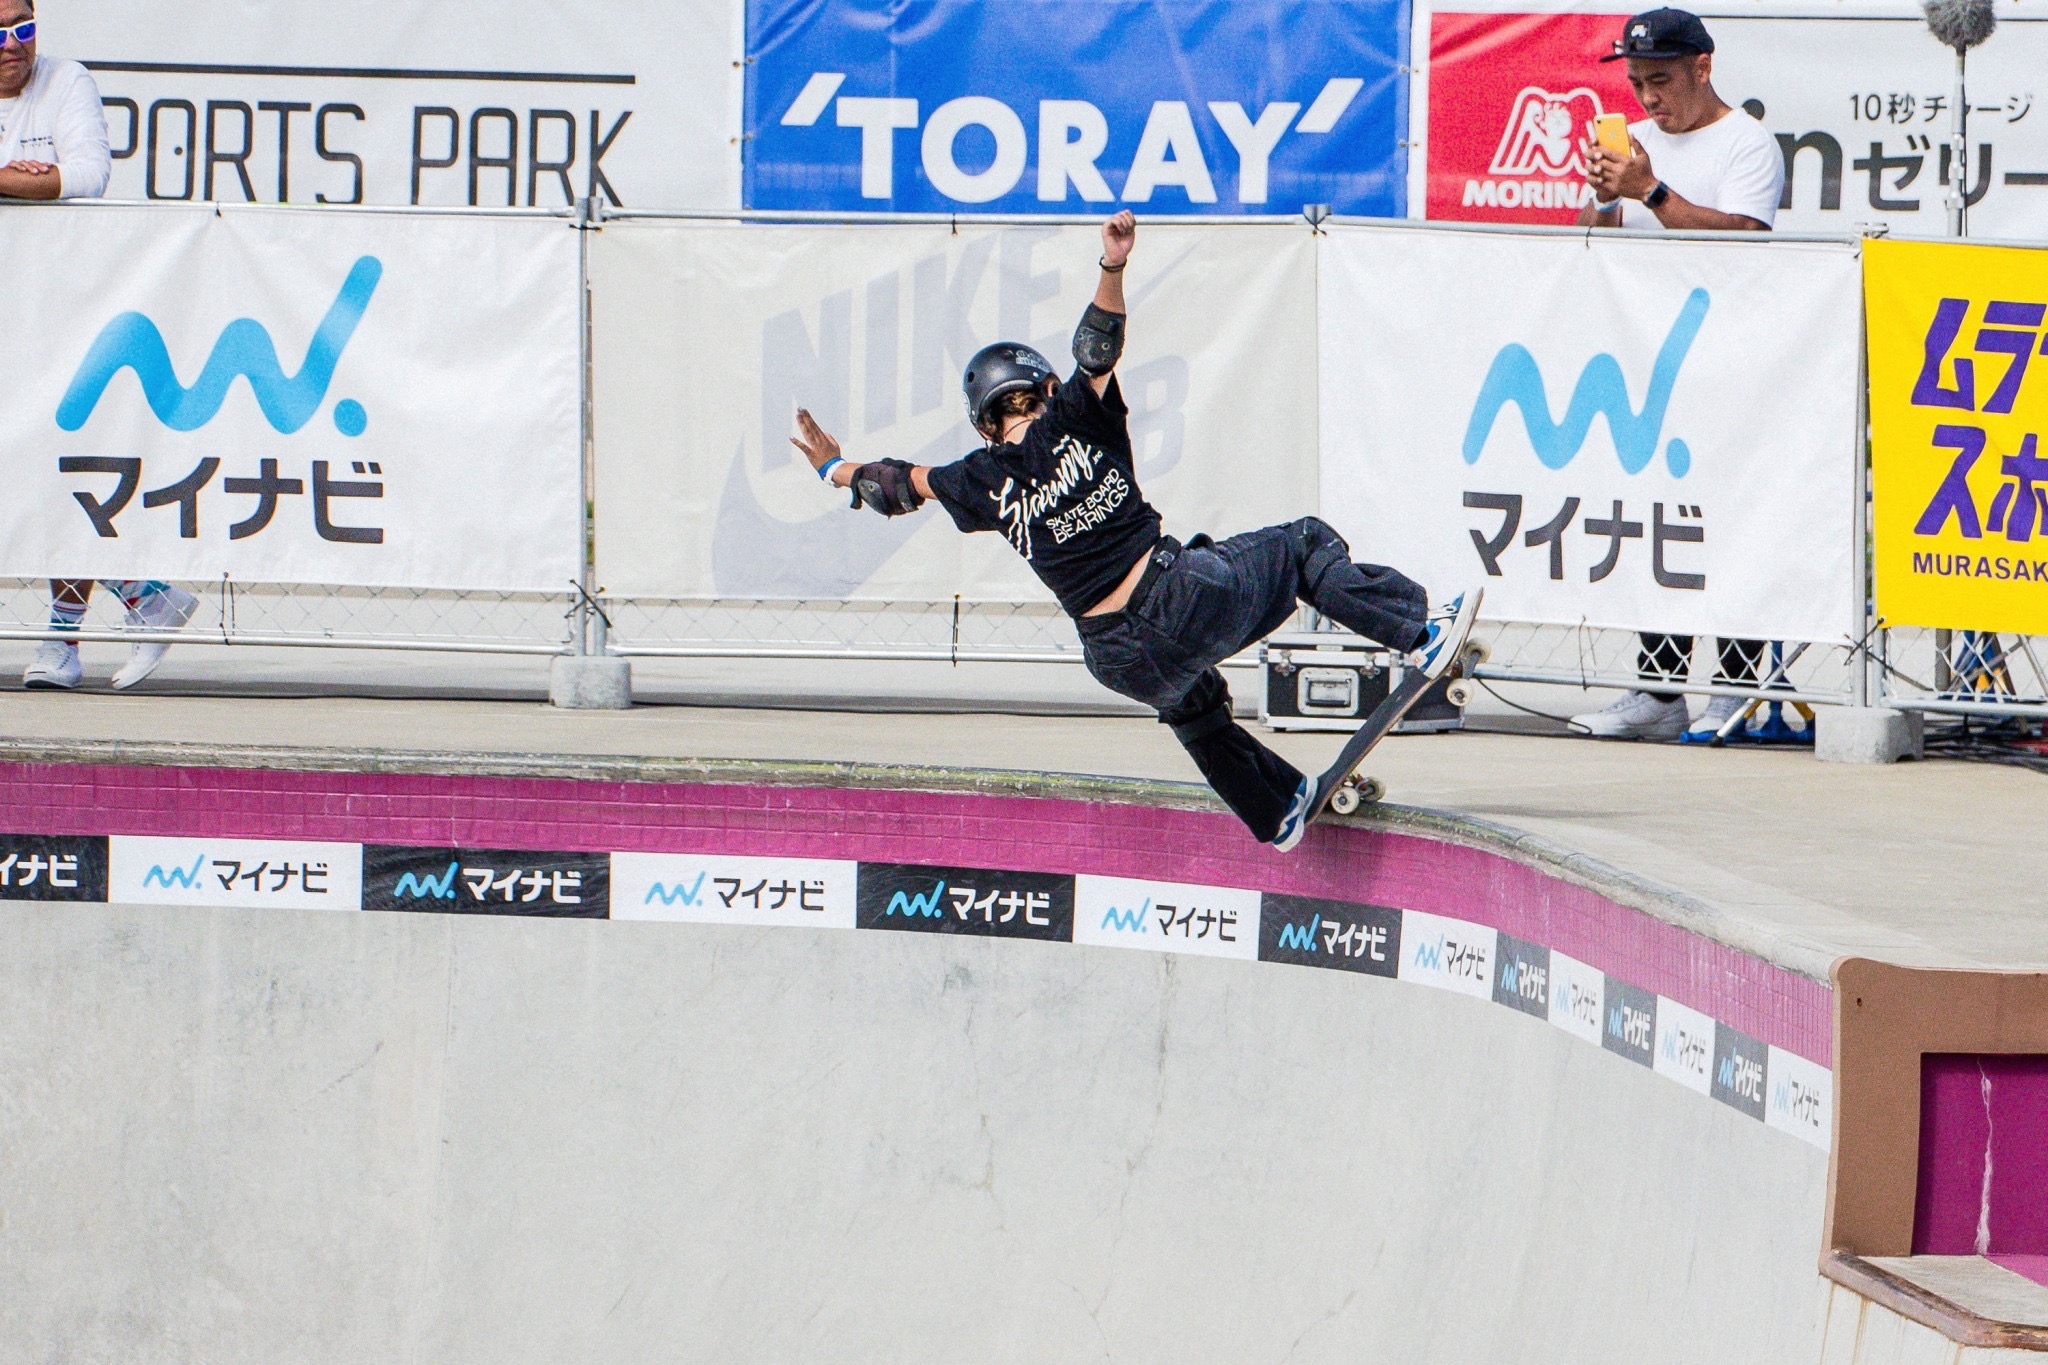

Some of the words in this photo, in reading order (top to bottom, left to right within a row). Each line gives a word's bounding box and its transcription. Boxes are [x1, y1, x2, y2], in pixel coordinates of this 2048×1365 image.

[1850, 93, 2033, 124] 10秒チージ
[411, 105, 634, 208] PARK
[761, 225, 1070, 474] NIKE
[1911, 297, 2048, 414] ムラ
[59, 456, 384, 545] マイナビ
[1046, 502, 1087, 530] SKATE
[1087, 467, 1120, 510] BOARD
[1052, 477, 1130, 545] BEARINGS
[1463, 491, 1706, 591] マイナビ
[212, 860, 328, 893] マイナビ
[463, 867, 582, 904] マイナビ
[713, 876, 825, 912] マイナビ
[948, 887, 1051, 926] マイナビ
[1155, 904, 1237, 943] マイナビ
[1321, 920, 1387, 962] マイナビ
[1446, 940, 1486, 981] マイナビ
[1518, 961, 1546, 1004] マイナビ
[1623, 1005, 1651, 1051] マイナビ
[1734, 1054, 1763, 1103] マイナビ
